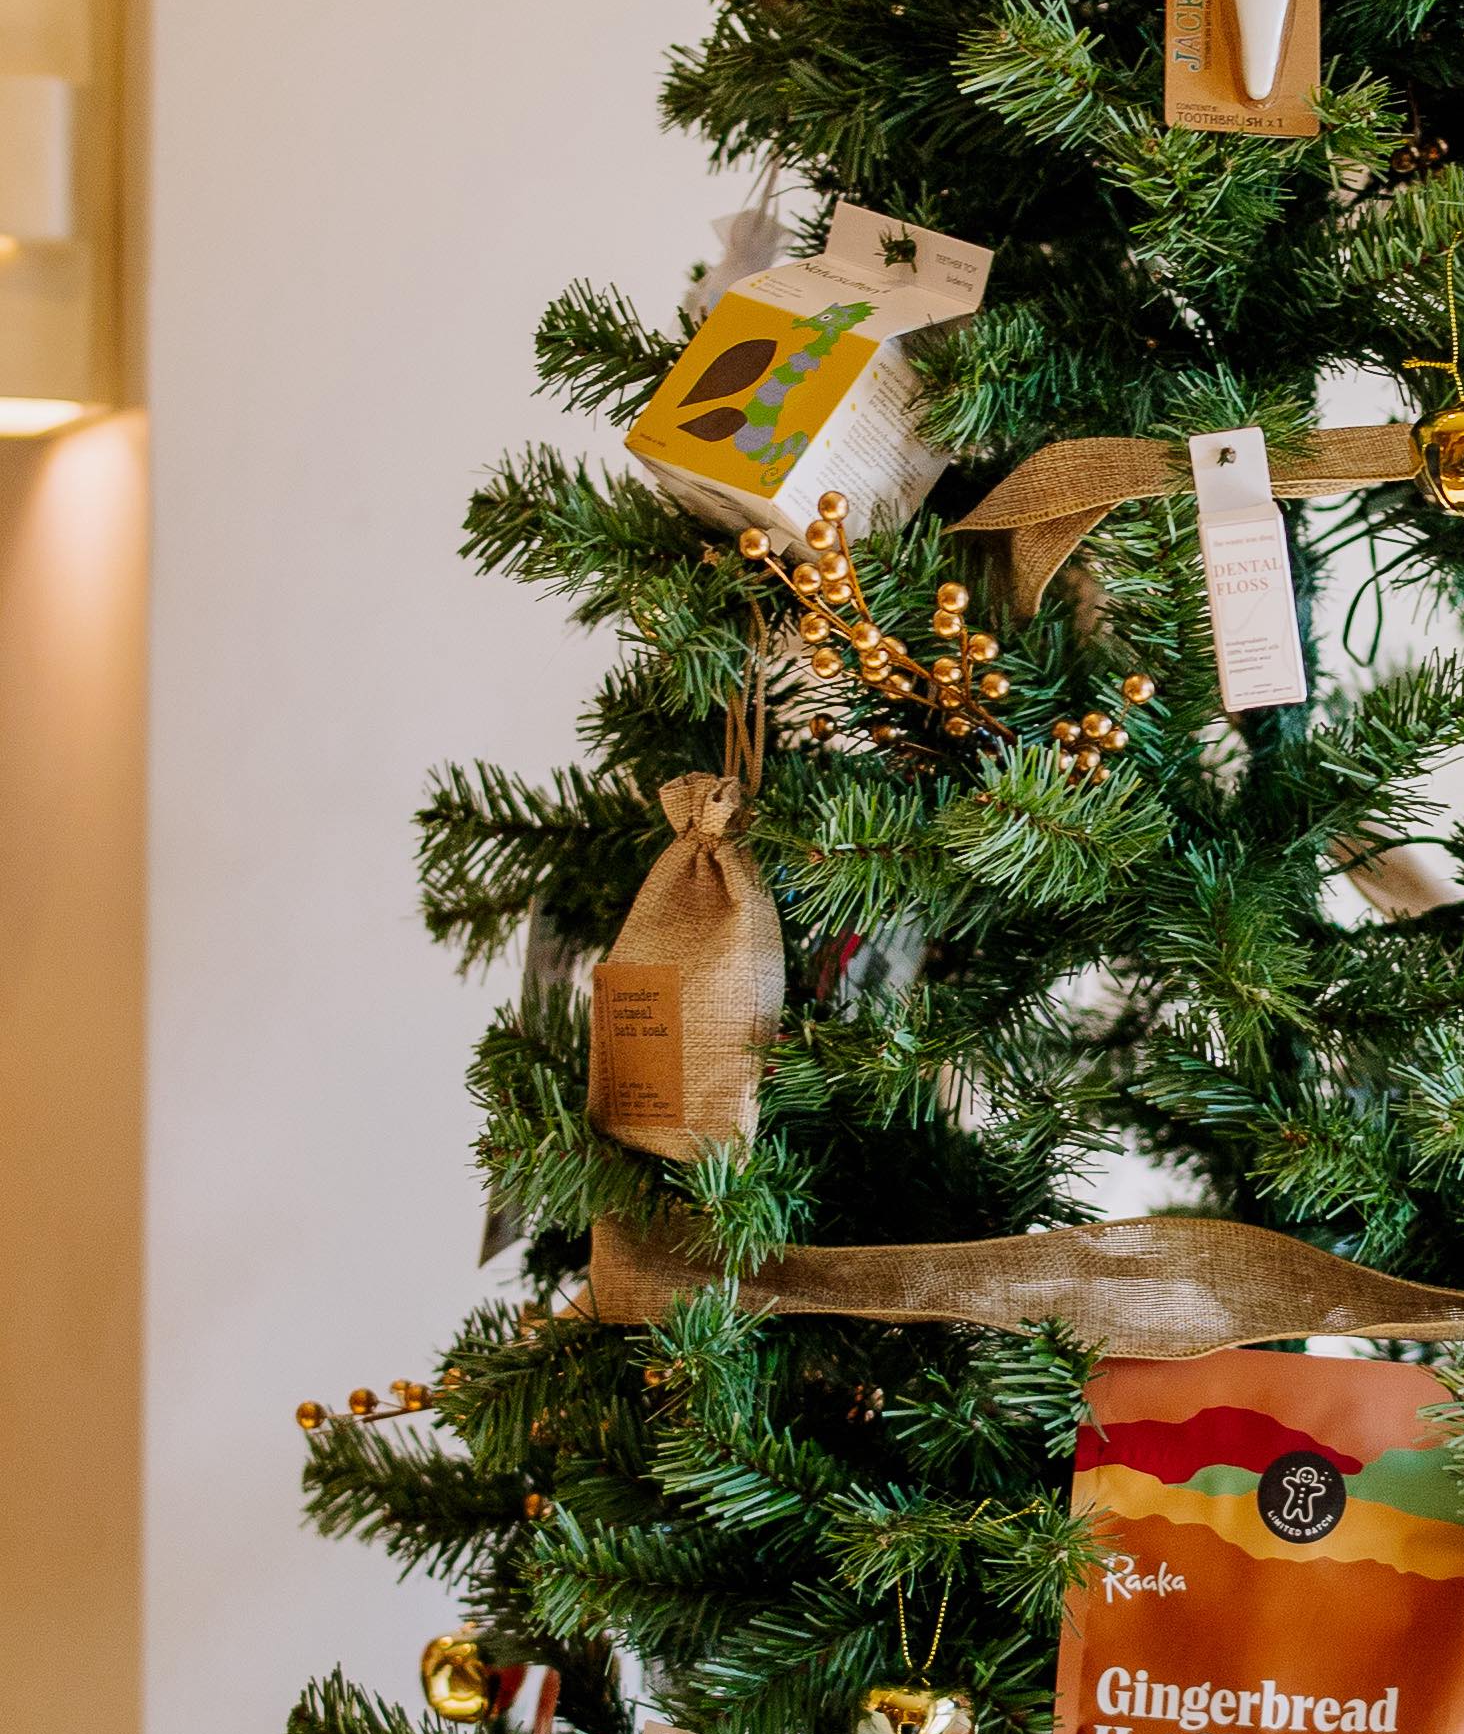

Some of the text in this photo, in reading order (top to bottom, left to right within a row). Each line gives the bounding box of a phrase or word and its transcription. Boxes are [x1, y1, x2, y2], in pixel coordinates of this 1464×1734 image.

[1176, 112, 1263, 127] TOOTHBRUSH
[1278, 117, 1284, 127] 1
[1213, 557, 1282, 579] DENTAL
[1215, 578, 1270, 597] FLOSS
[612, 988, 660, 1003] lavender
[613, 1005, 653, 1019] oatmeal
[614, 1023, 669, 1037] bath soak
[1267, 1510, 1335, 1537] LIMITED BATCH
[1102, 1555, 1187, 1603] Raaka
[1096, 1666, 1400, 1732] Gingerbread
